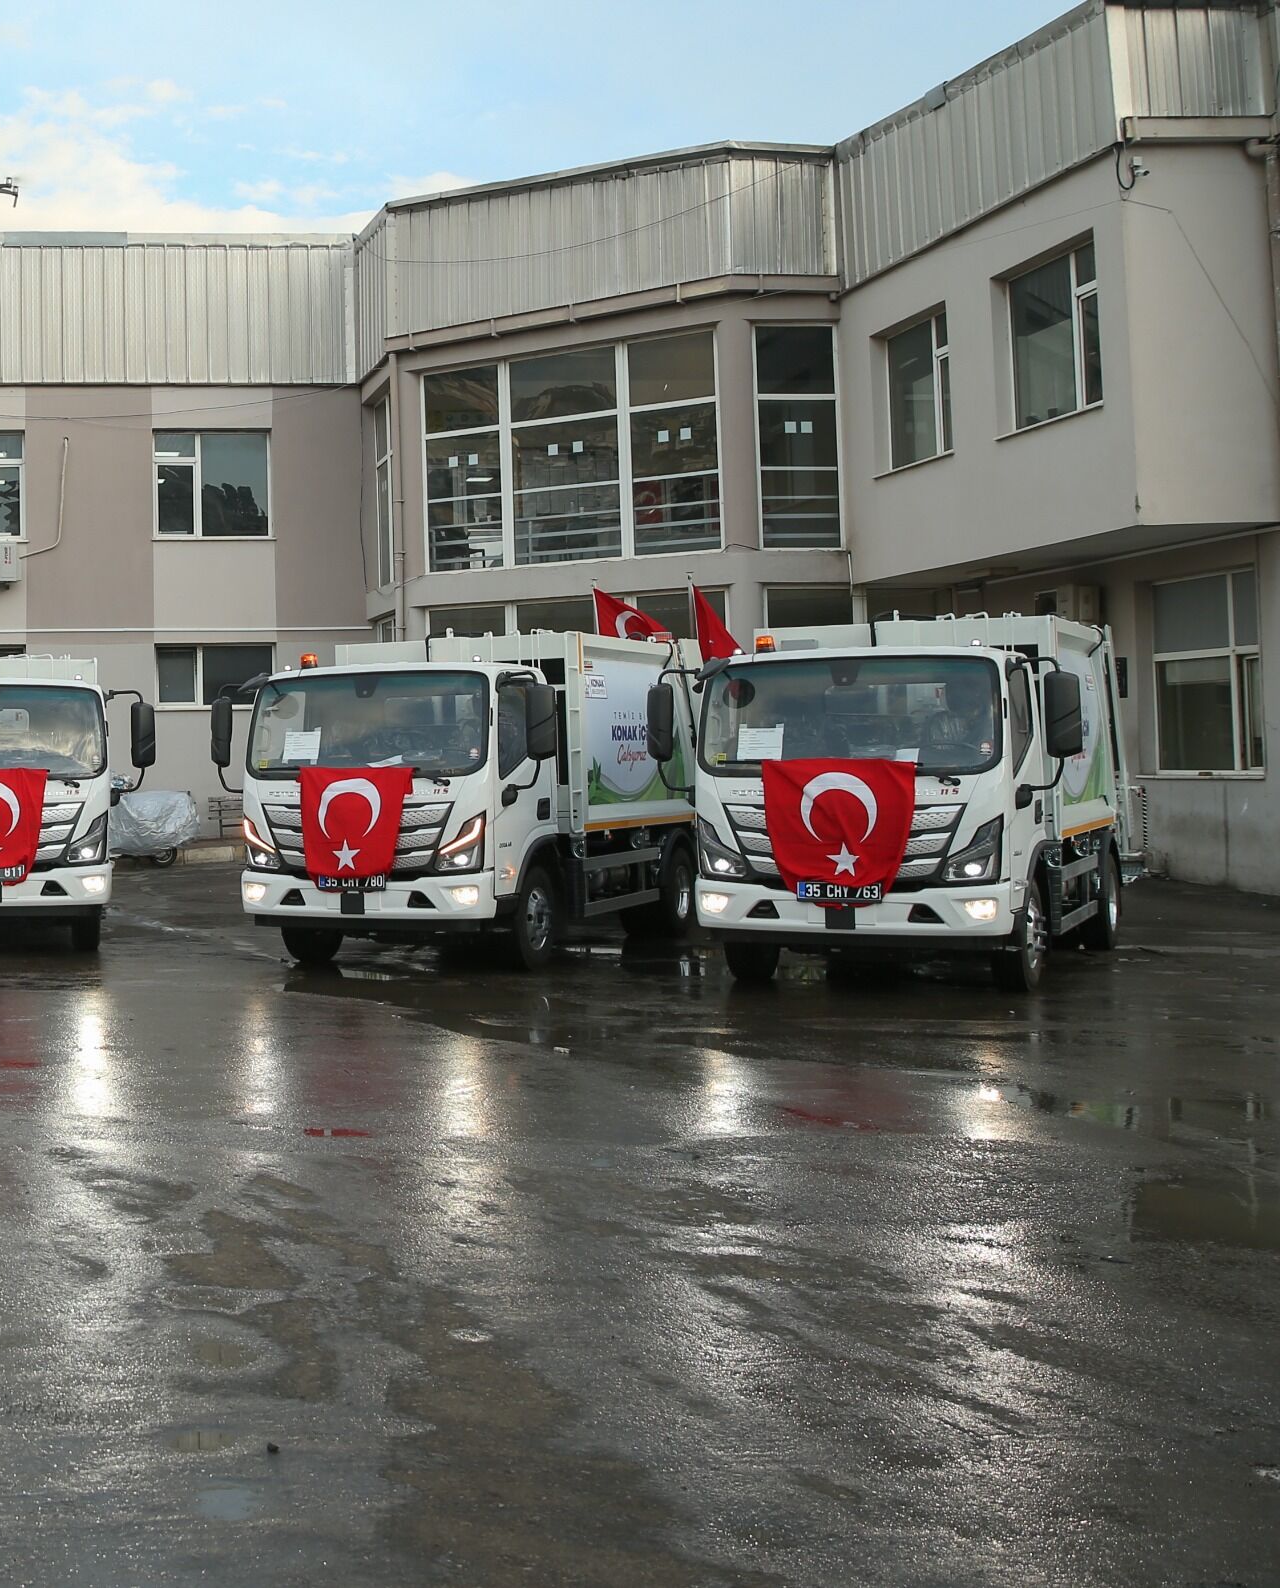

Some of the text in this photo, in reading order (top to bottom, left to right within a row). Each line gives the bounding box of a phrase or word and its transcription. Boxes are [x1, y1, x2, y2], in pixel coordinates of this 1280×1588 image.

[612, 725, 637, 741] KONAK
[5, 866, 22, 877] 811
[325, 875, 337, 887] 35
[342, 877, 360, 887] CHY
[805, 883, 821, 897] 35
[827, 884, 848, 897] CHY
